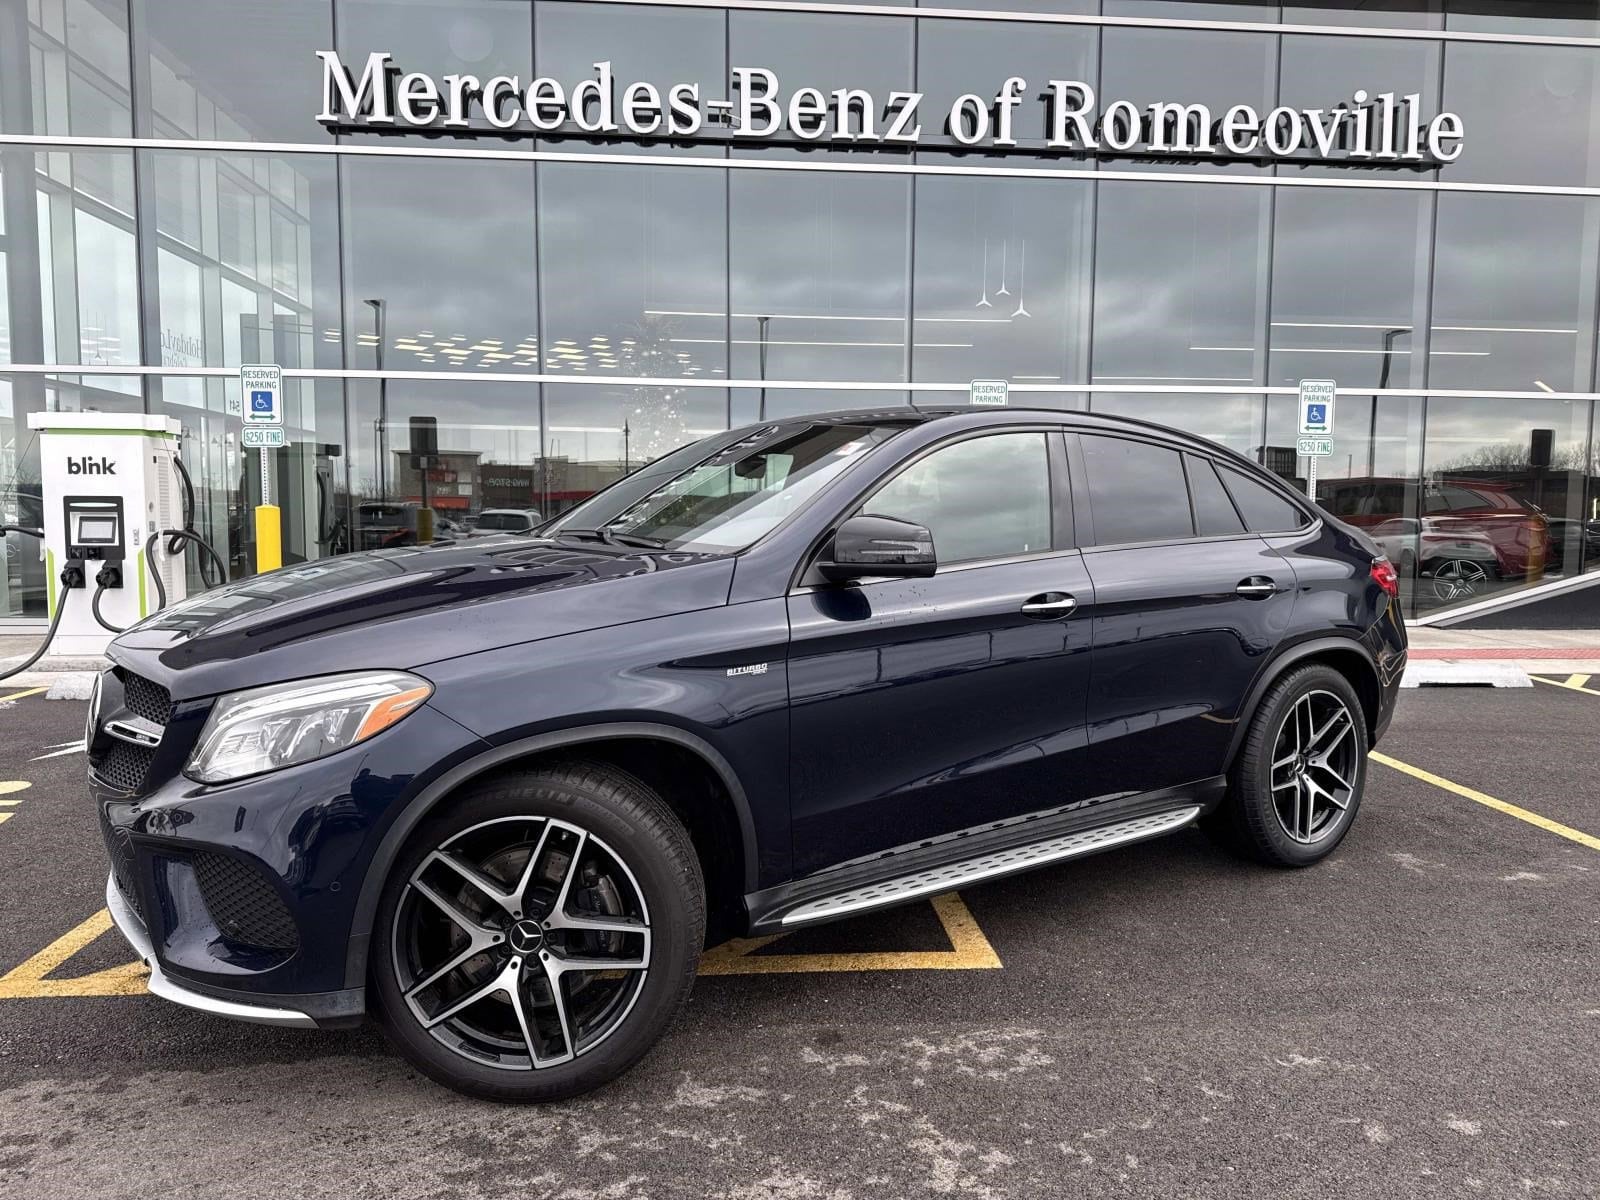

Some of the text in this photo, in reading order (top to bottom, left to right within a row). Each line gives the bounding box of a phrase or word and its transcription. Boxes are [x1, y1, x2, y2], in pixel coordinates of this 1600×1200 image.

[315, 50, 1465, 162] Mercedes-Benz of Romeoville
[242, 370, 279, 379] RESERVED
[245, 381, 277, 389] PARKING
[973, 385, 1006, 394] RESERVED
[1302, 385, 1333, 393] RESERVED
[975, 395, 1003, 404] PARKING
[1303, 395, 1331, 403] PARKING
[245, 431, 282, 443] $250 FINE
[1299, 441, 1330, 453] $250 FINE
[67, 456, 117, 475] blink
